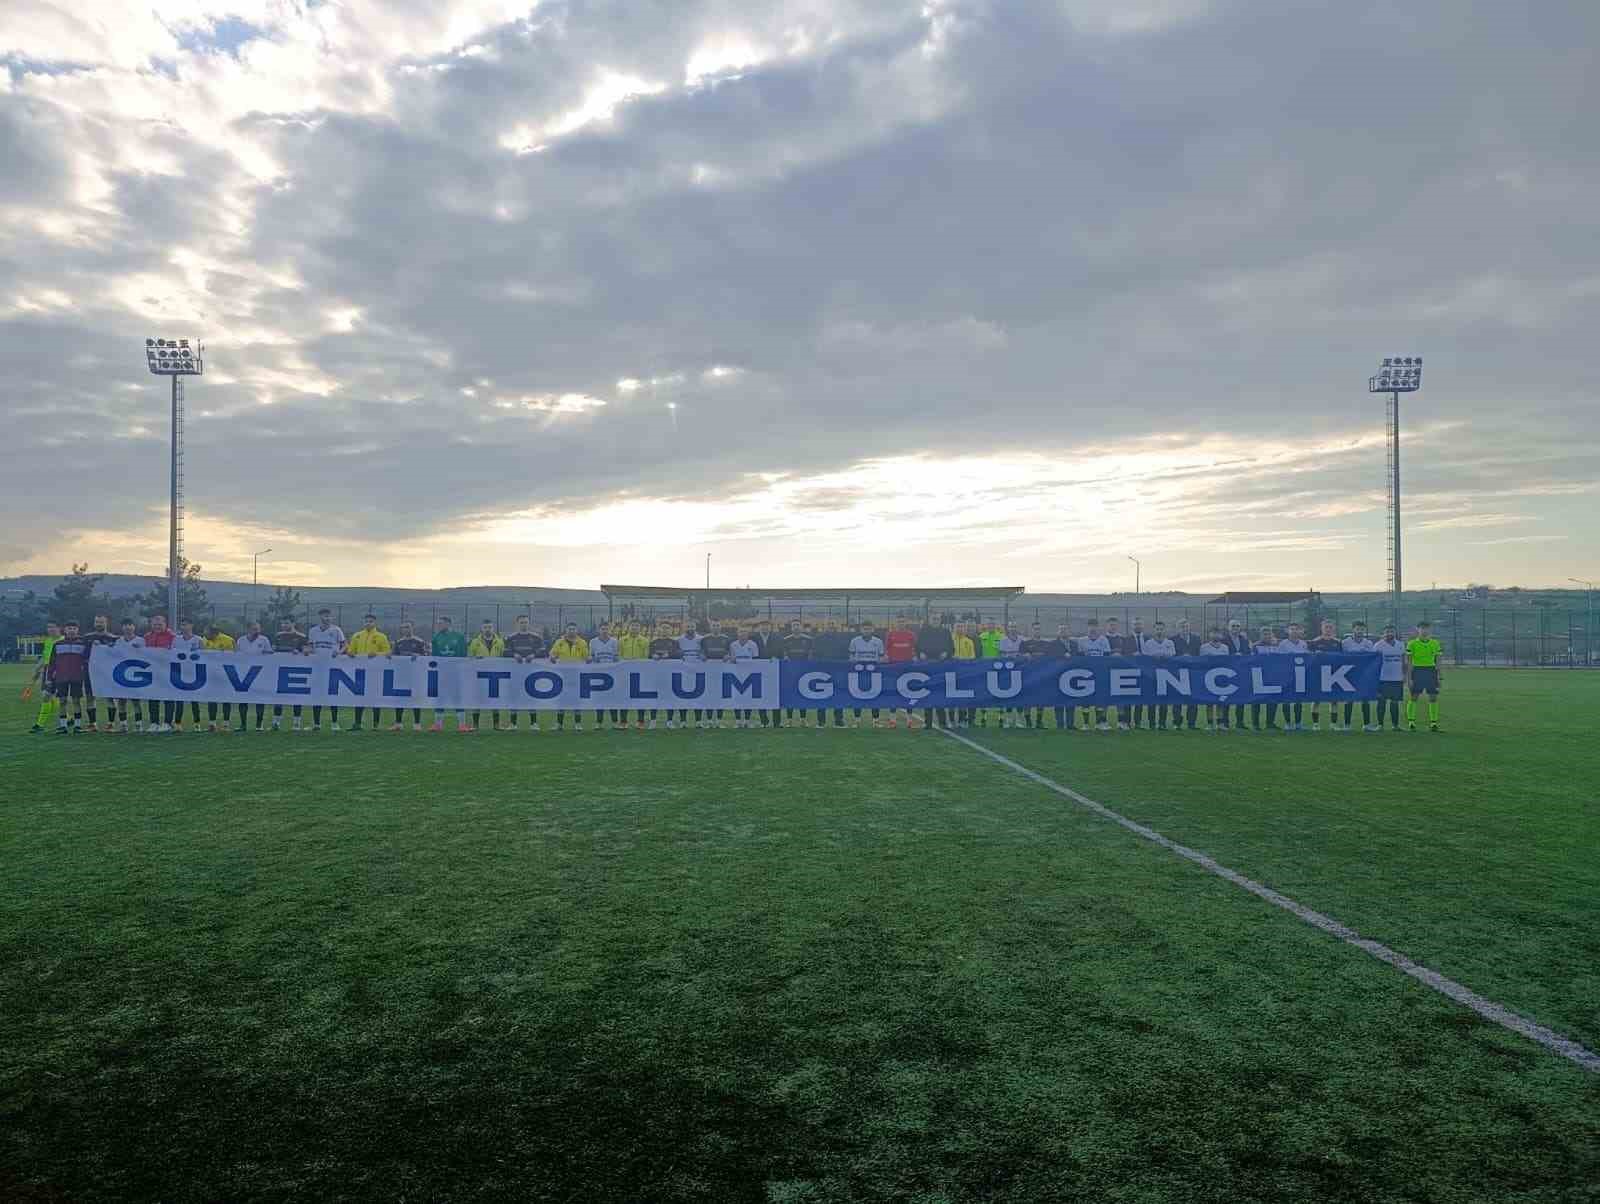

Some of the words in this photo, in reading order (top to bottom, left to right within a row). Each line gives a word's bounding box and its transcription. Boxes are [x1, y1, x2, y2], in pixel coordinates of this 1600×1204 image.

[112, 652, 439, 698] GÜVENLİ
[476, 671, 762, 699] TOPLUM
[798, 661, 1023, 704] GÜÇLÜ
[1058, 656, 1356, 702] GENÇLİK
